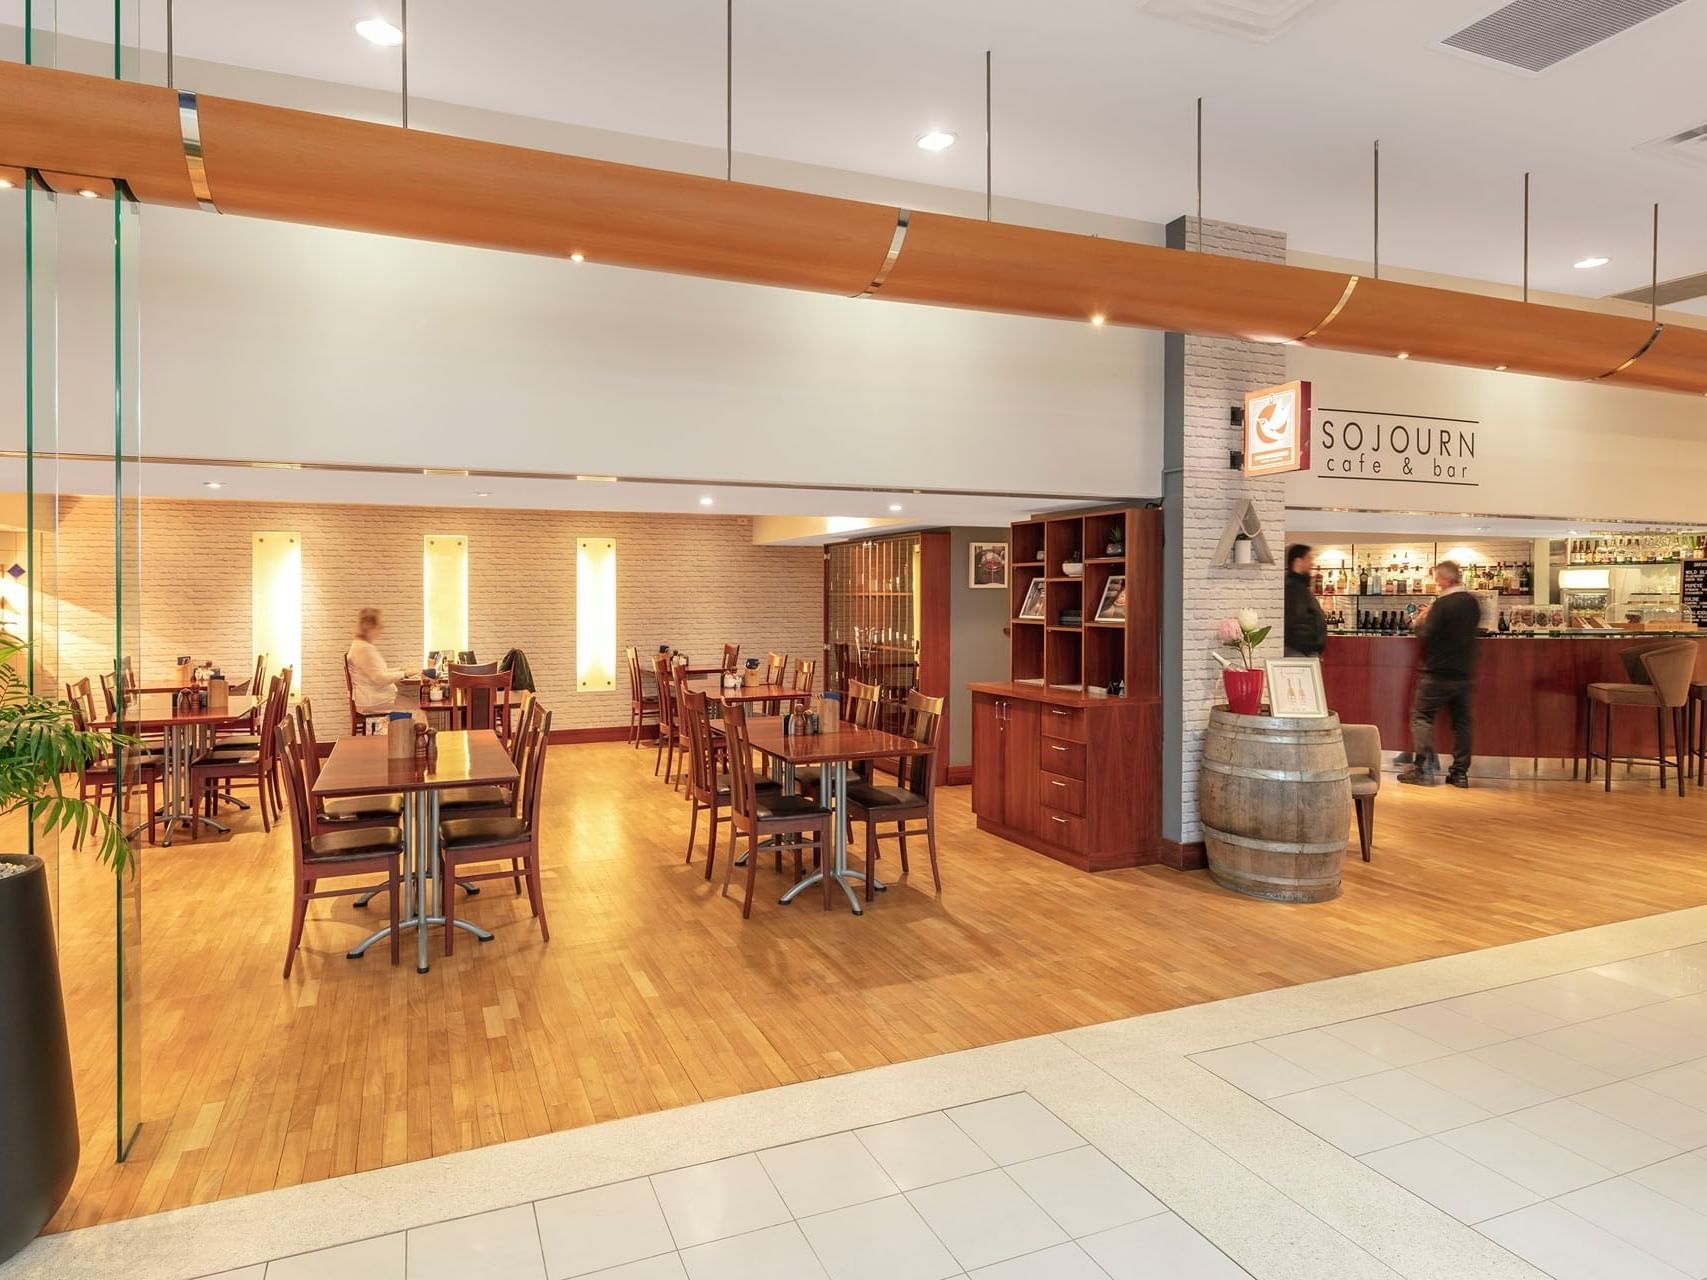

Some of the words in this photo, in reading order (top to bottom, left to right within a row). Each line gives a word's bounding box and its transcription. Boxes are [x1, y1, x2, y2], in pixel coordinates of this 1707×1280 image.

[1322, 420, 1475, 458] SOJOURN
[1326, 453, 1382, 474] cafe
[1402, 456, 1414, 476] &
[1433, 457, 1469, 479] bar
